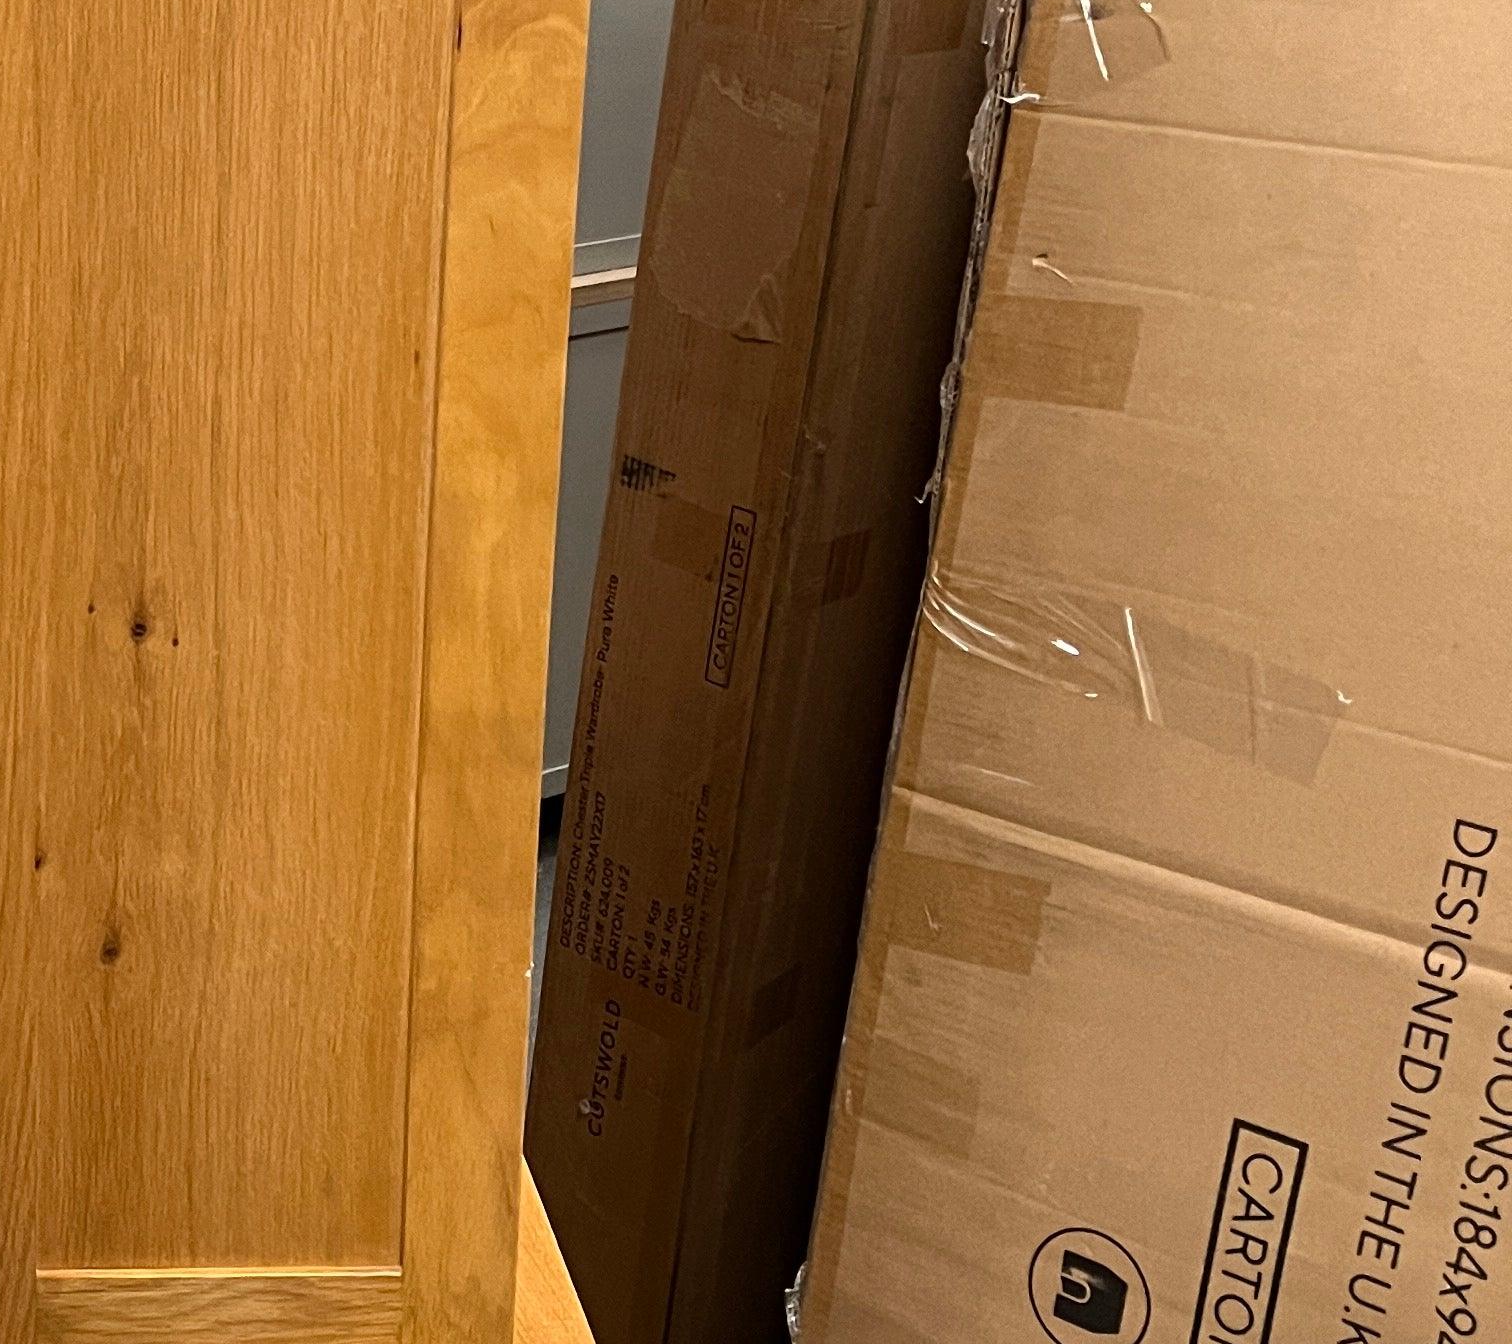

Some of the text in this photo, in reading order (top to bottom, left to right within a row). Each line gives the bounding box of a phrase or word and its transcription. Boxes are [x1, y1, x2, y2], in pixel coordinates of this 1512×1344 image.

[729, 537, 746, 569] OF
[734, 522, 750, 536] 2
[603, 574, 620, 623] White
[597, 626, 613, 663] Pure
[713, 584, 739, 671] CARTON
[619, 864, 630, 877] 2
[1398, 818, 1498, 1095] DESIGNED
[588, 999, 621, 1137] COTSWOLD
[1380, 1101, 1432, 1161] IN
[1356, 1167, 1418, 1270] THE
